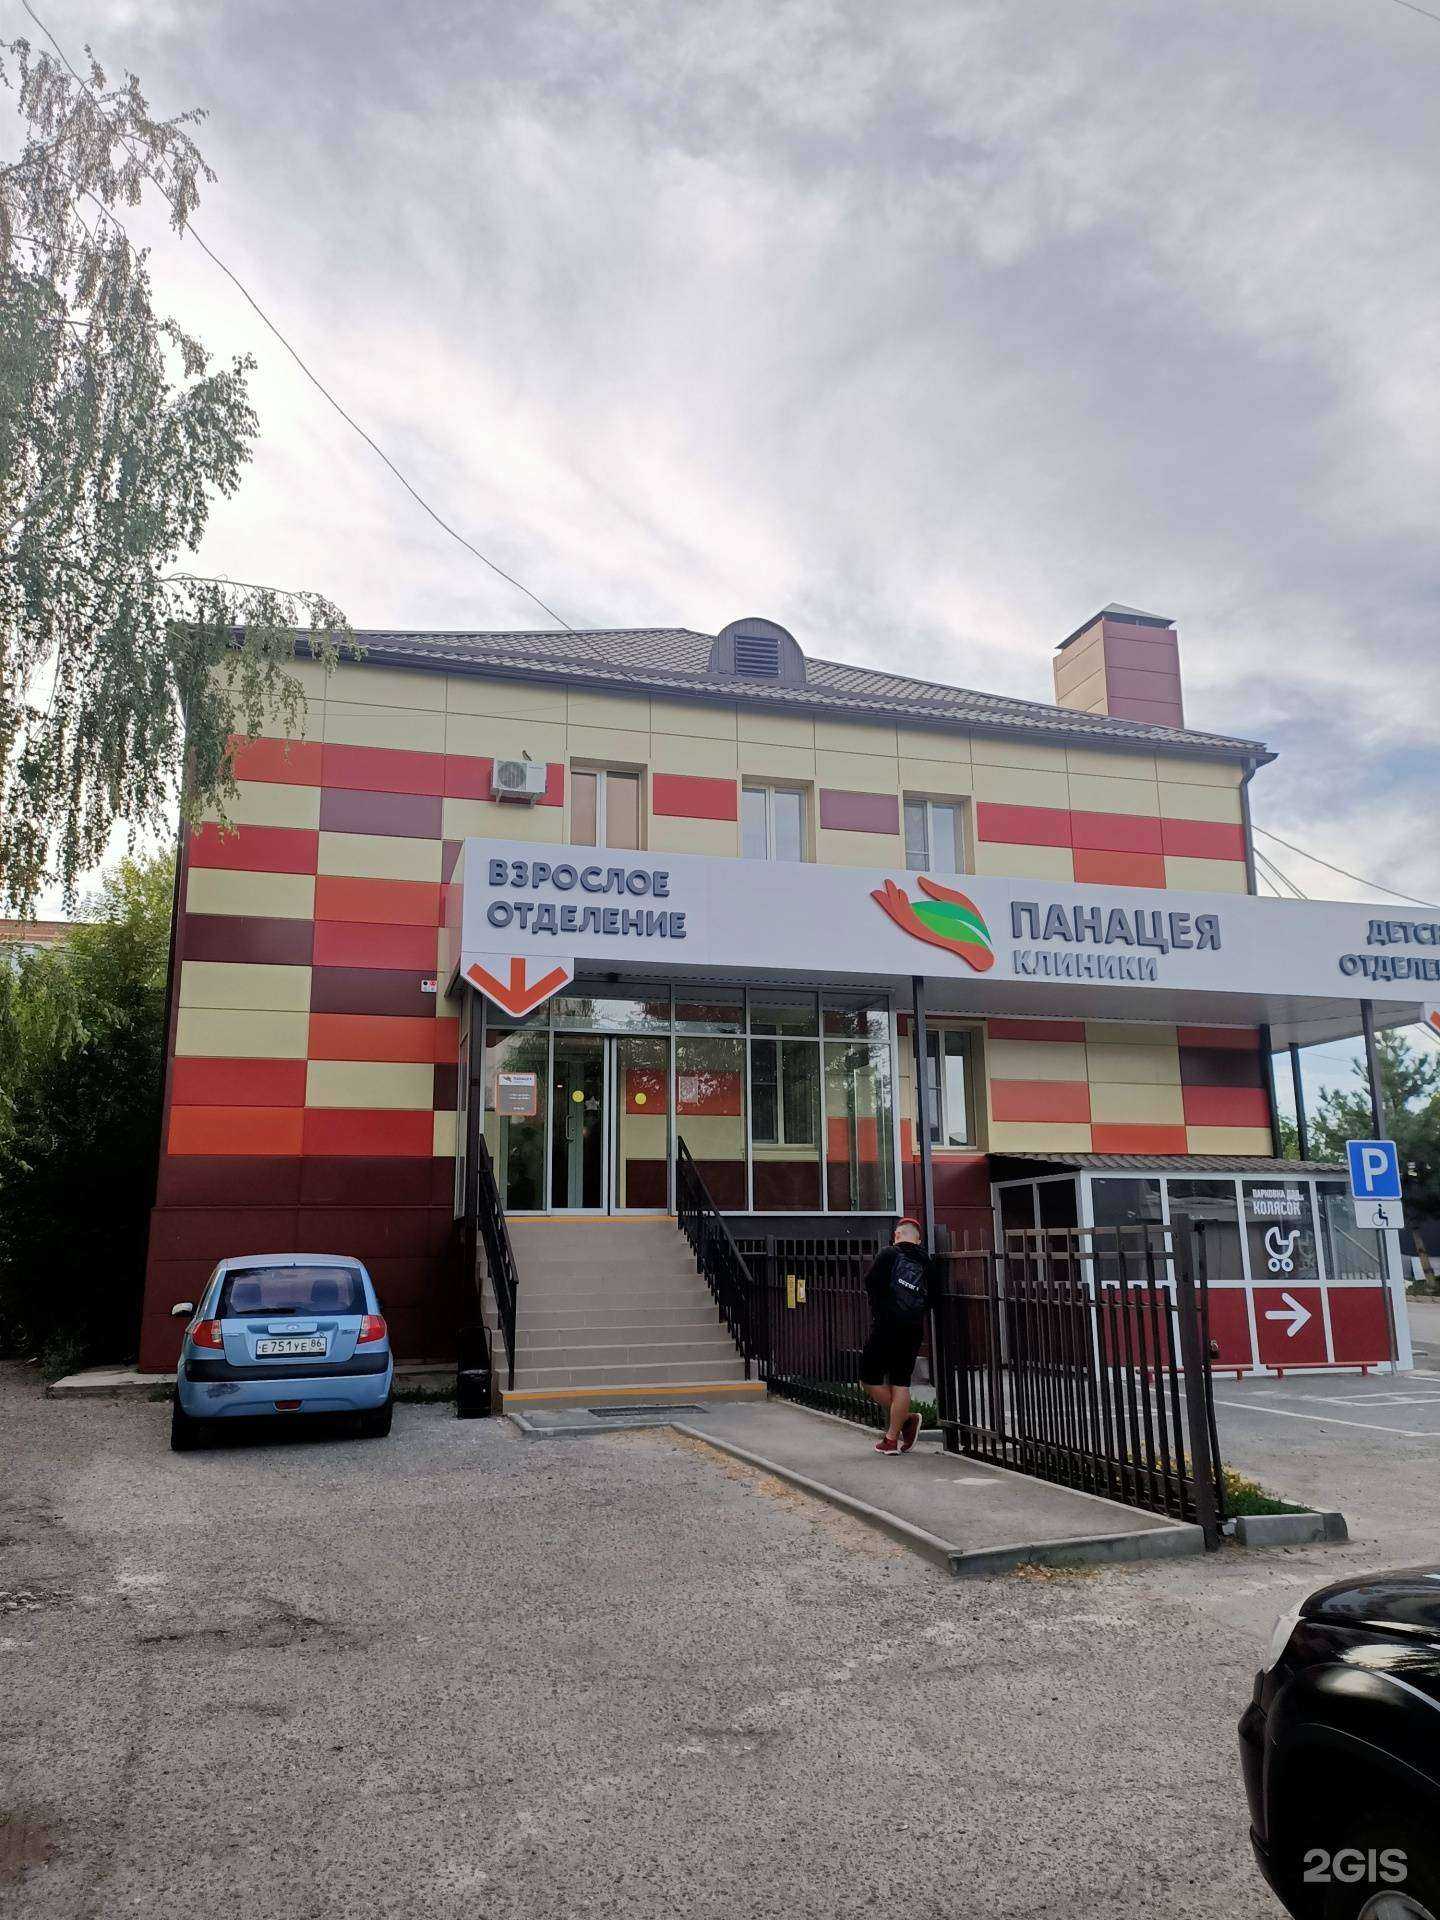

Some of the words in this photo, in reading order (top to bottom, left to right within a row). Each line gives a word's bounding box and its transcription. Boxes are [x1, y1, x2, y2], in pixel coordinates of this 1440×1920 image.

[488, 858, 670, 897] ВЗРОСЛОЕ
[487, 899, 687, 939] ОТДЕЛЕНИЕ
[1011, 901, 1222, 954] ПАНАЦЕЯ
[1013, 949, 1159, 982] КЛИНИКИ
[1339, 953, 1440, 982] ОТДЕЛЕ
[1361, 1147, 1389, 1192] P
[1253, 1200, 1302, 1216] КОЛЯСОК
[310, 1339, 322, 1348] 86
